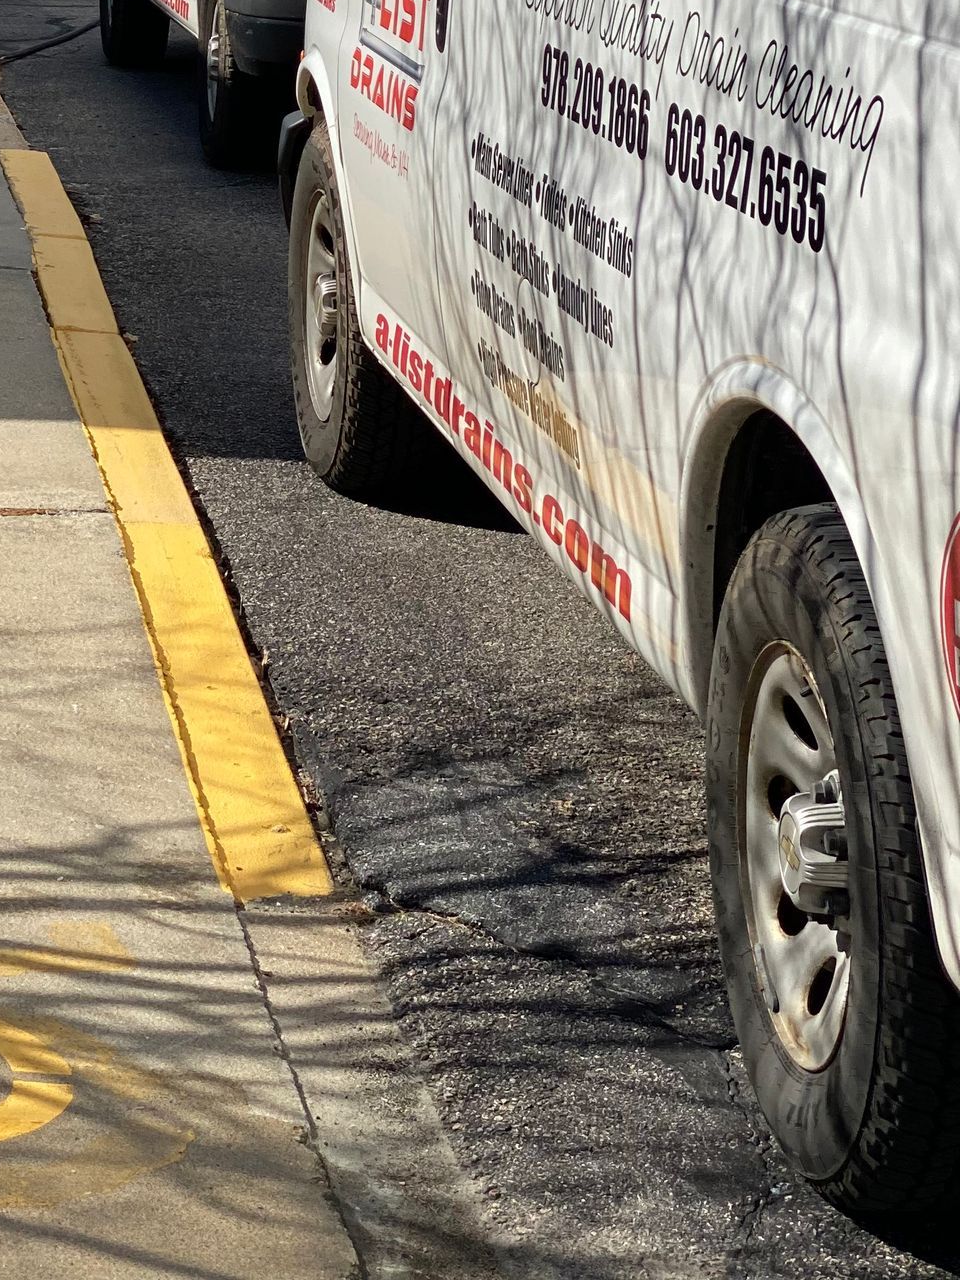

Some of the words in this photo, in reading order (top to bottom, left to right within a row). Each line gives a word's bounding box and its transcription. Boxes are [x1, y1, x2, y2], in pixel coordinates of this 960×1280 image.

[350, 46, 419, 132] DRAINS
[541, 43, 651, 161] 978.209.1866
[664, 102, 828, 253] 603.327.6535
[676, 11, 749, 102] Drain
[755, 39, 885, 198] Cleaning
[473, 201, 488, 250] Bath
[488, 212, 505, 263] Tubs
[512, 229, 528, 279] Bath
[528, 242, 550, 298] Sinks
[557, 263, 589, 334] Laundry
[590, 287, 614, 348] Lines
[475, 132, 492, 180] Main
[492, 142, 514, 195] Sewer
[513, 157, 534, 209] Lines
[540, 174, 567, 232] Toilets
[573, 196, 607, 260] Kitchen
[607, 217, 633, 278] Sinks
[475, 269, 492, 321] Floor
[491, 283, 515, 339] Drains
[538, 320, 565, 383] Drains
[480, 336, 498, 389] High
[496, 350, 530, 417] Pressure
[527, 379, 552, 439] Water
